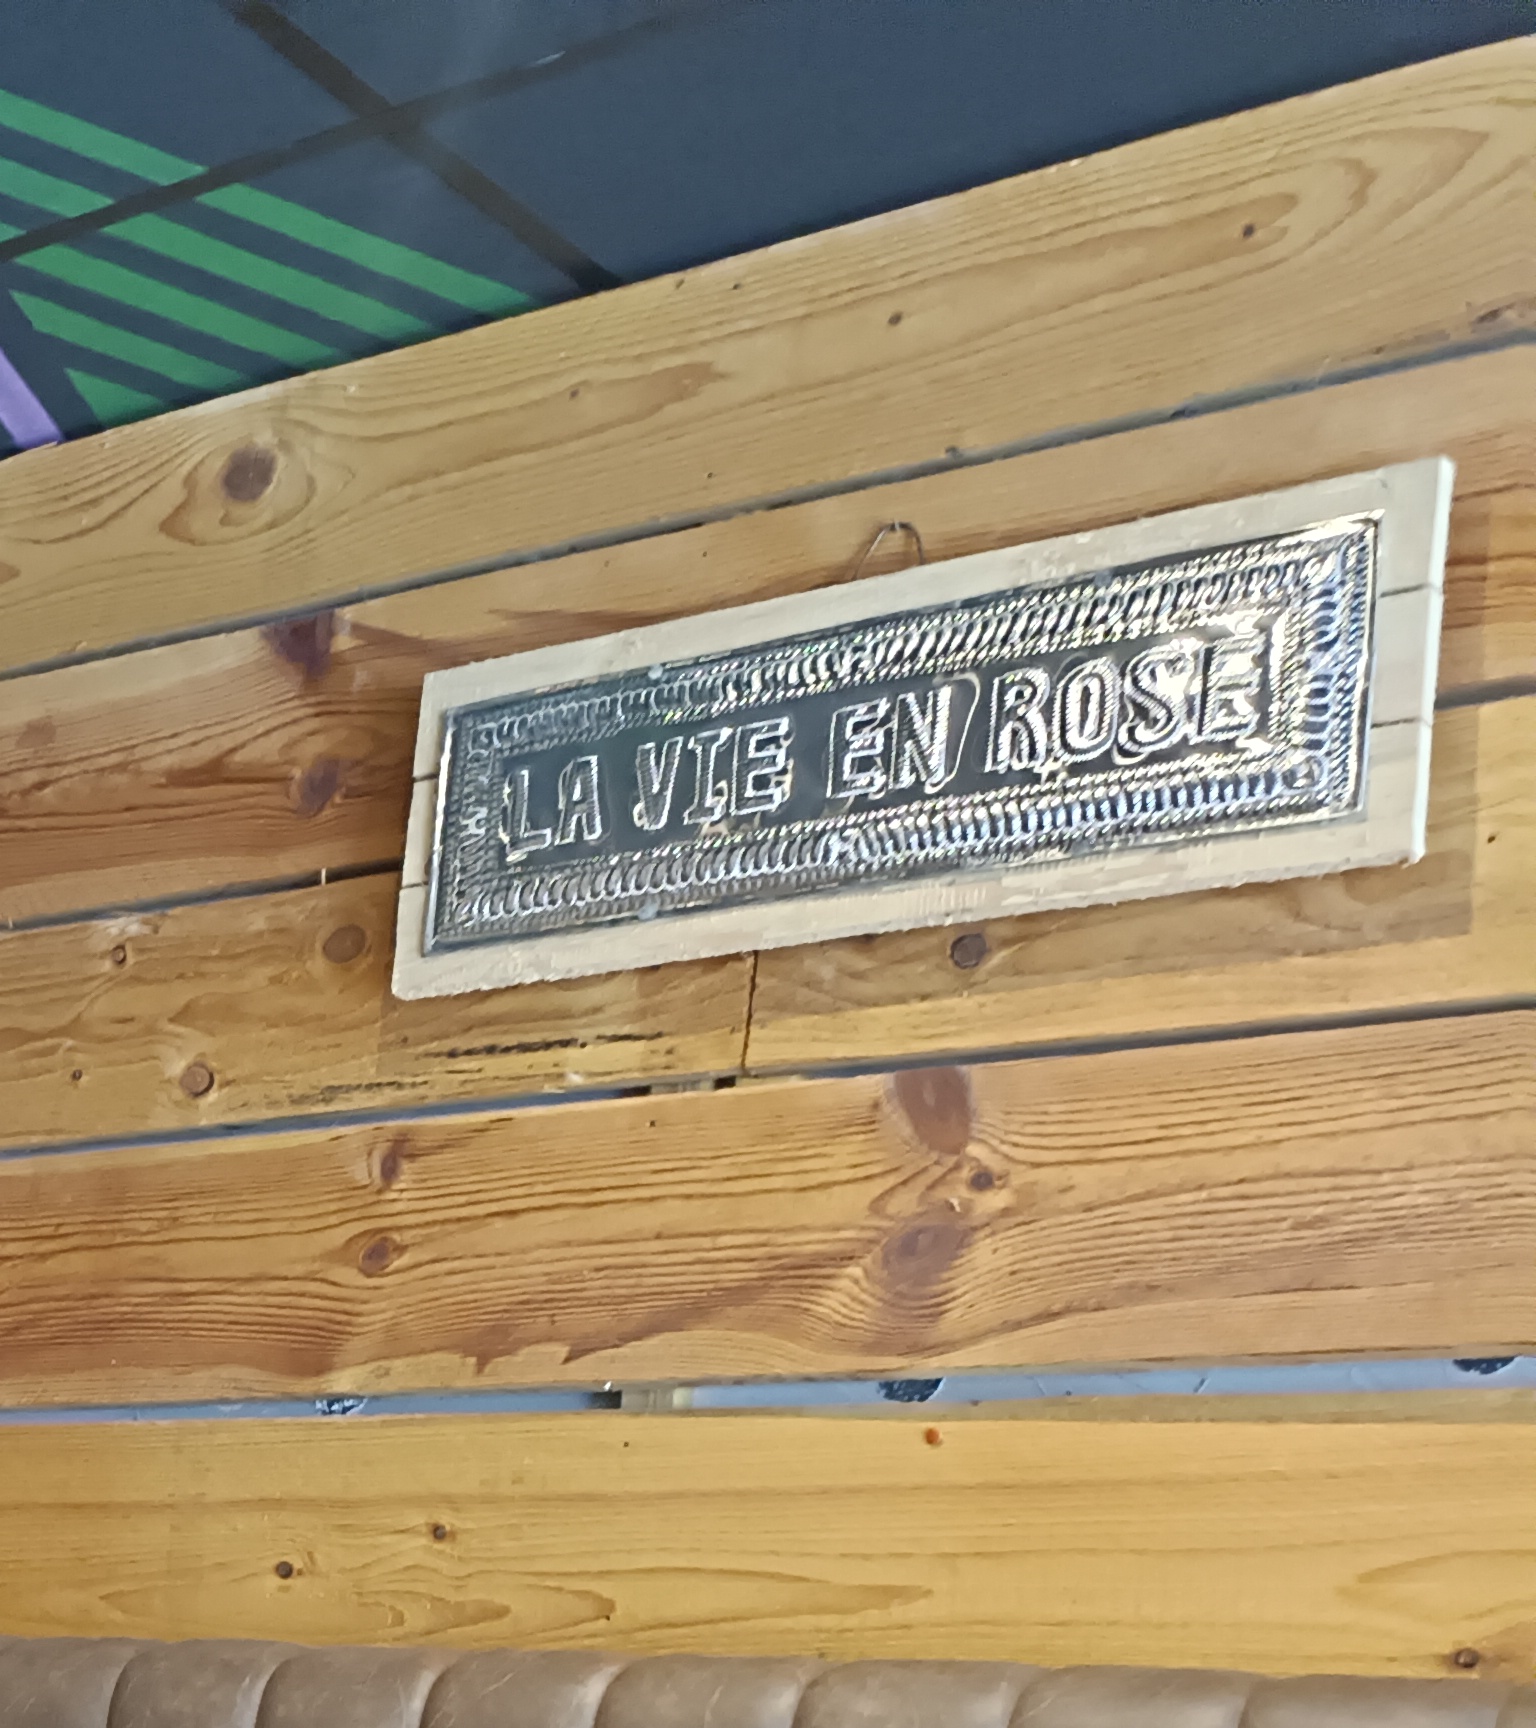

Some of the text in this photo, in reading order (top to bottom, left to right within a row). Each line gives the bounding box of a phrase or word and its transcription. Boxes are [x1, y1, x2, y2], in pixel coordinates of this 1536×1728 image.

[501, 633, 1266, 862] LA VIE EN ROSE
